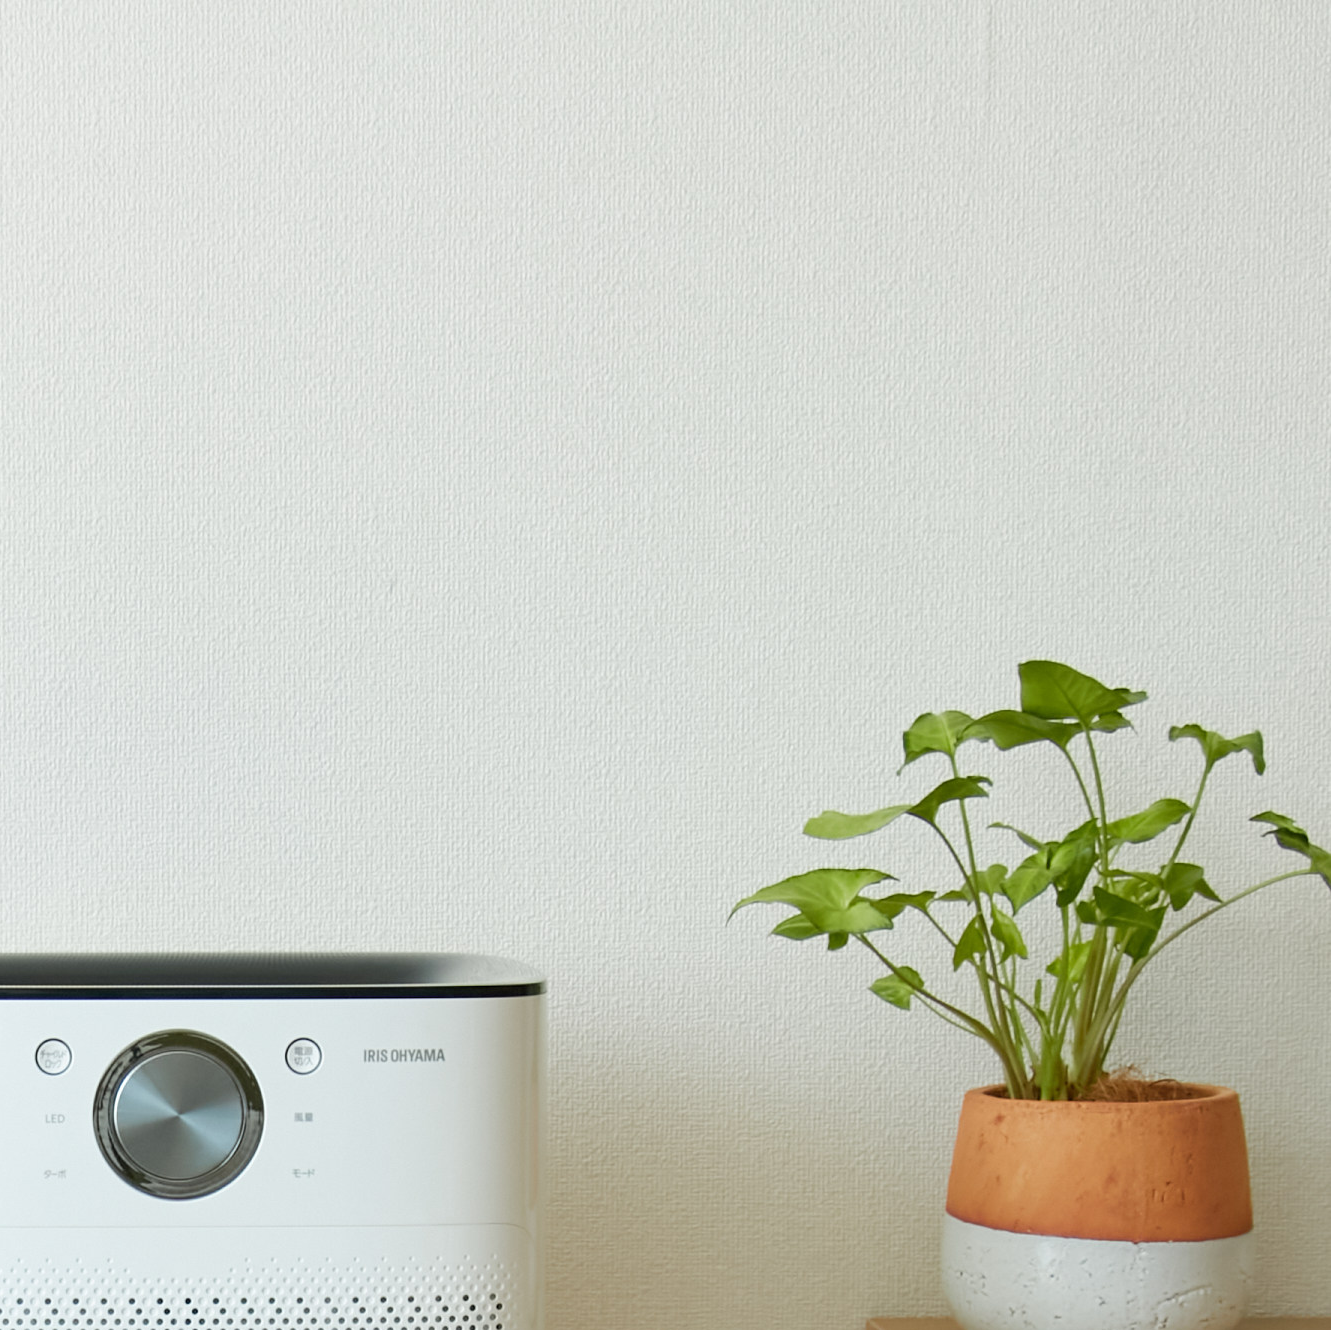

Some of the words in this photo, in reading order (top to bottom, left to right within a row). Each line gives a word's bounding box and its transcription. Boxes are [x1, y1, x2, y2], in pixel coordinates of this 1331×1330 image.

[363, 1049, 388, 1063] IRIS
[390, 1048, 446, 1063] OHYAMA
[45, 1114, 66, 1124] LED
[292, 1168, 316, 1178] モード
